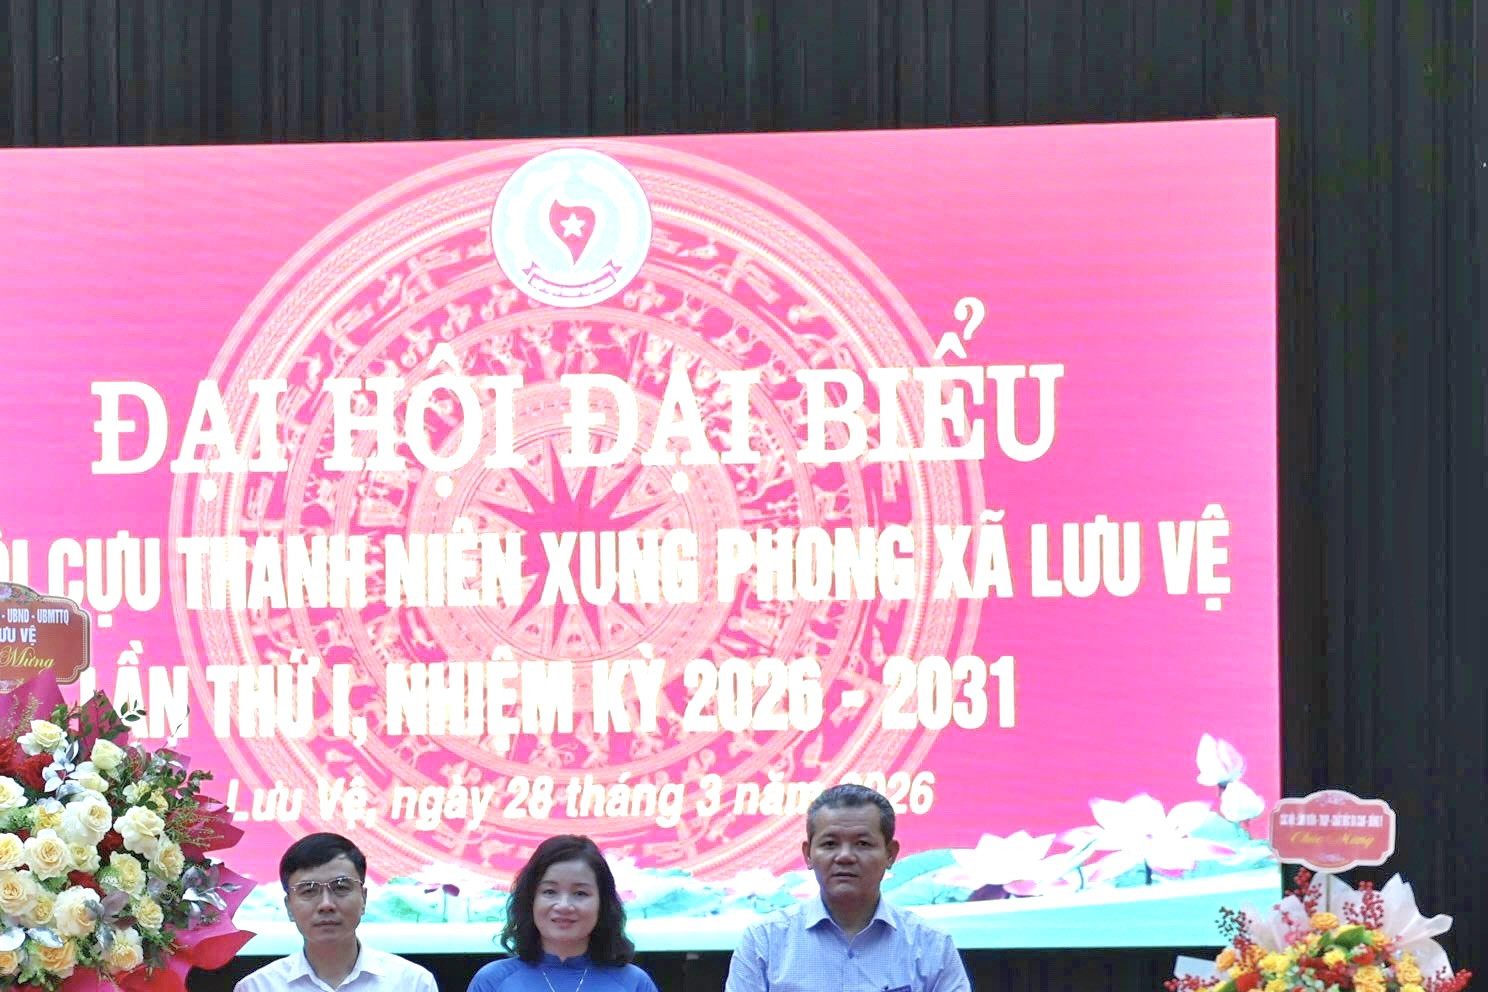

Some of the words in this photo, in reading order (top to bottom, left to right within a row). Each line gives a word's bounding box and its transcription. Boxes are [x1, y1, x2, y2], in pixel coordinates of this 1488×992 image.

[90, 378, 288, 501] ĐẠI
[324, 343, 524, 497] HỘI
[562, 368, 760, 494] ĐẠI
[797, 297, 1065, 463] BIỂU
[48, 530, 160, 628] CỰU
[177, 534, 366, 610] THANH
[385, 516, 522, 607] NIÊN
[540, 527, 698, 606] XUNG
[717, 524, 914, 602] PHONG
[933, 509, 1013, 599] XÃ
[1031, 514, 1141, 598] LƯU
[1158, 503, 1231, 611] VỆ
[8, 608, 29, 623] UBND
[37, 608, 70, 626] UBMTTQ
[20, 625, 37, 646] VỆ
[206, 648, 320, 738] THỨ
[332, 664, 367, 746] I,
[386, 645, 573, 752] NHIỆM
[683, 656, 824, 732] 2026
[841, 690, 864, 707] -
[882, 655, 1015, 730] 2031
[227, 778, 303, 821] Lưu
[317, 775, 376, 829] Vệ,
[391, 773, 494, 831] ngày
[503, 775, 554, 819] 28
[566, 772, 685, 828] tháng
[696, 773, 722, 816] 3
[733, 770, 823, 816] năm
